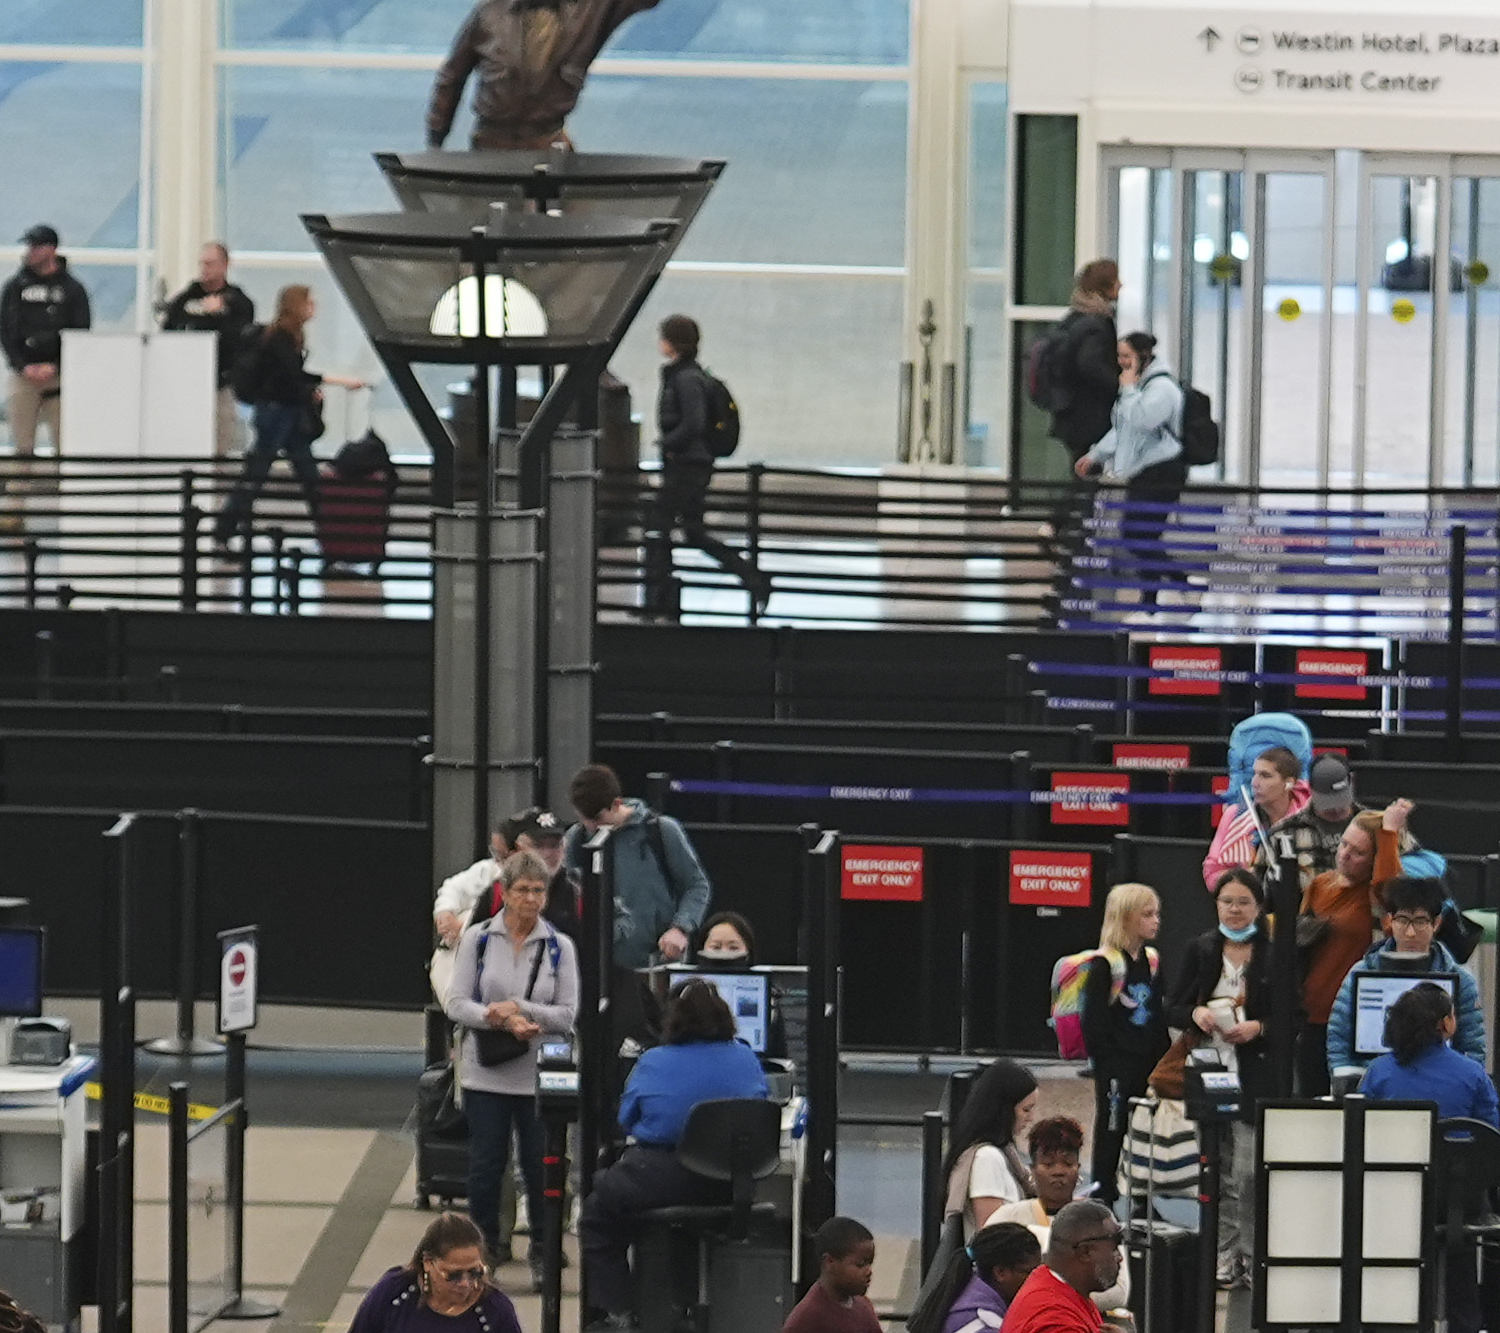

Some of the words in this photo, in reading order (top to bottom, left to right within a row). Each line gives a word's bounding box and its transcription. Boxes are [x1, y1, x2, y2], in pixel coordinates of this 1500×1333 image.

[1273, 33, 1357, 53] Westin
[1364, 33, 1431, 56] Hotel,
[1440, 34, 1500, 55] Plaza
[1273, 71, 1352, 91] Transit
[1361, 71, 1442, 91] Center
[1152, 659, 1217, 671] EMERGENCY
[1299, 661, 1365, 675] EMERGENCY
[1174, 669, 1224, 681] EMERGENCY
[1228, 670, 1248, 682] EXIT
[1410, 677, 1431, 688] EXIT
[1116, 757, 1188, 768] EMERGENCY
[831, 788, 888, 800] EMERGENCY
[890, 789, 912, 801] EXIT
[1030, 791, 1087, 803] EMERGENCY
[1090, 792, 1111, 804] EXIT
[844, 858, 921, 873] EMERGENCY
[1012, 864, 1089, 879] EMERGENCY
[852, 873, 878, 885] EXIT
[881, 874, 913, 886] ONLY
[1020, 879, 1045, 891] EXIT
[1048, 880, 1080, 892] ONLY
